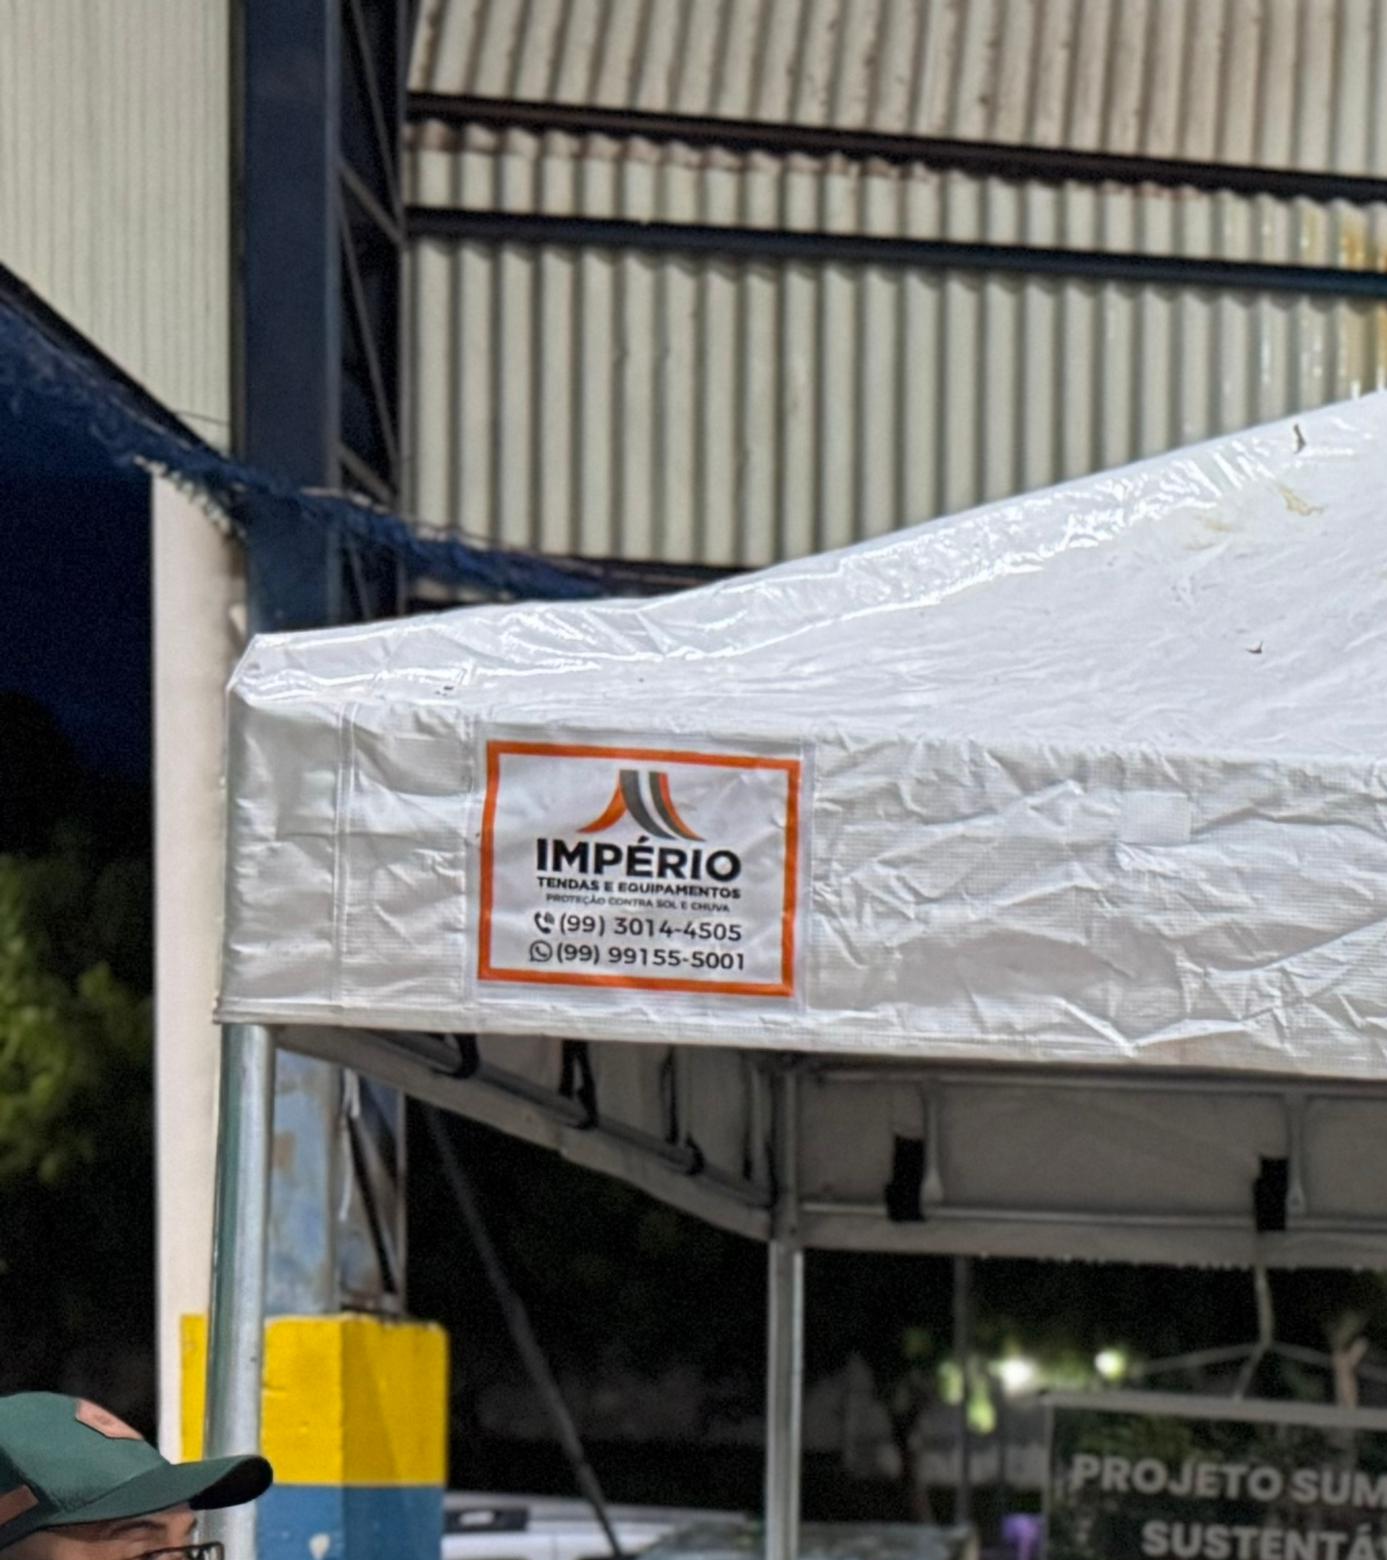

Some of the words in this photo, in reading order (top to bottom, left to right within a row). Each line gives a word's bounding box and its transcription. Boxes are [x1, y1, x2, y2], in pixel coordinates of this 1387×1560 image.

[536, 836, 742, 882] IMPÉRIO
[537, 876, 600, 892] TENDAS
[604, 881, 614, 893] E
[618, 882, 741, 899] EQUIPAMENTOS
[546, 893, 606, 907] PROTEÇÃO
[608, 897, 654, 908] CONTRA
[656, 899, 678, 910] SOL
[681, 901, 688, 911] E
[691, 902, 730, 913] CHUVA
[560, 913, 606, 937] (99)
[613, 916, 743, 942] 3014-4505
[556, 942, 601, 965] (99)
[608, 946, 745, 971] 99155-5001
[1067, 1453, 1284, 1500] PROJETO
